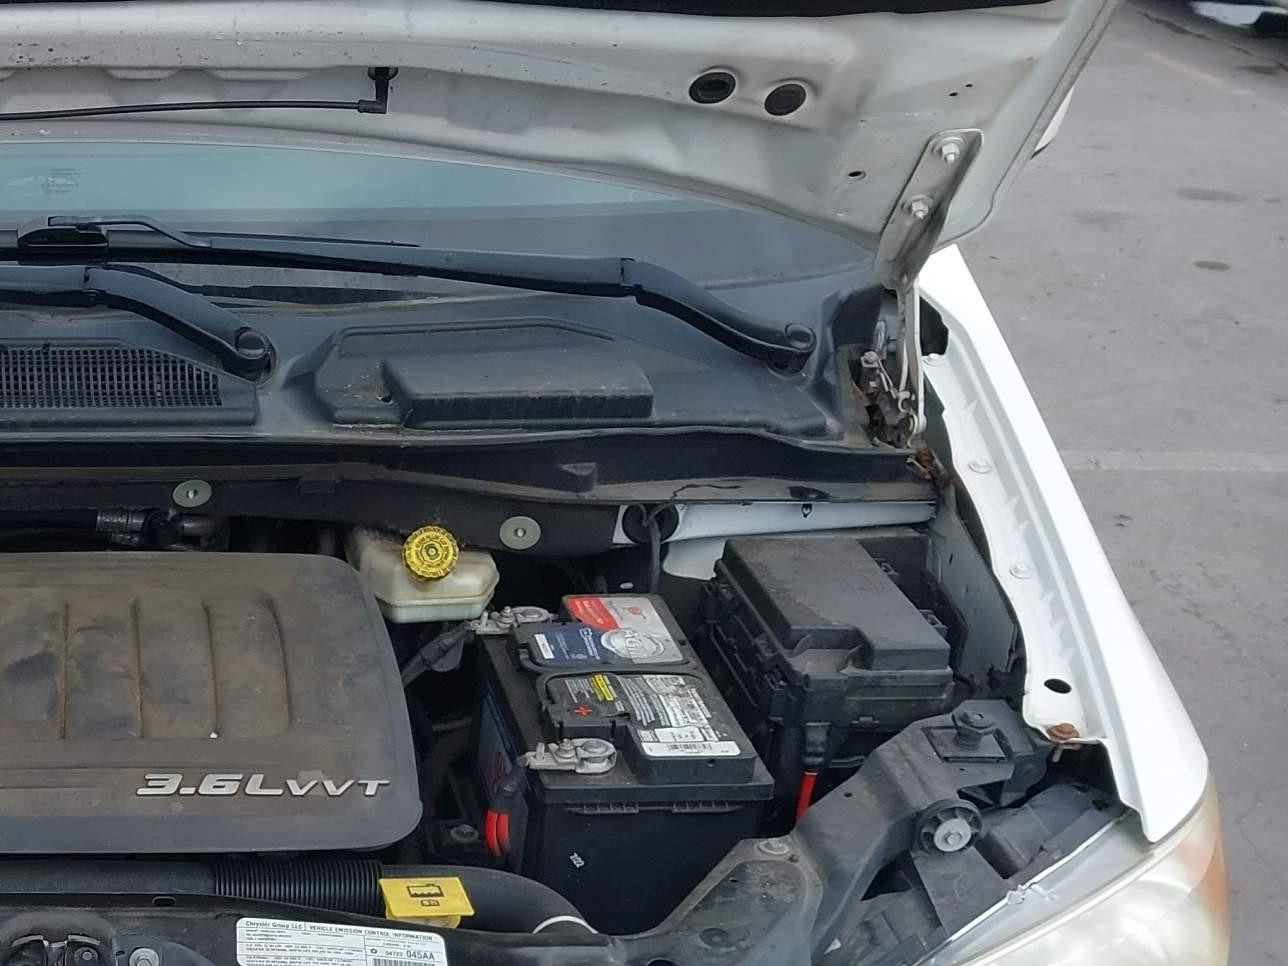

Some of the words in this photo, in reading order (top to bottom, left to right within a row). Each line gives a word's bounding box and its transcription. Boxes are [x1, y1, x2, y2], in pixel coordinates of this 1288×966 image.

[245, 920, 270, 928] Chrysler
[272, 922, 290, 930] Group
[364, 929, 390, 937] CONTROL
[392, 931, 433, 941] INFORMATION
[406, 951, 435, 961] 045AA
